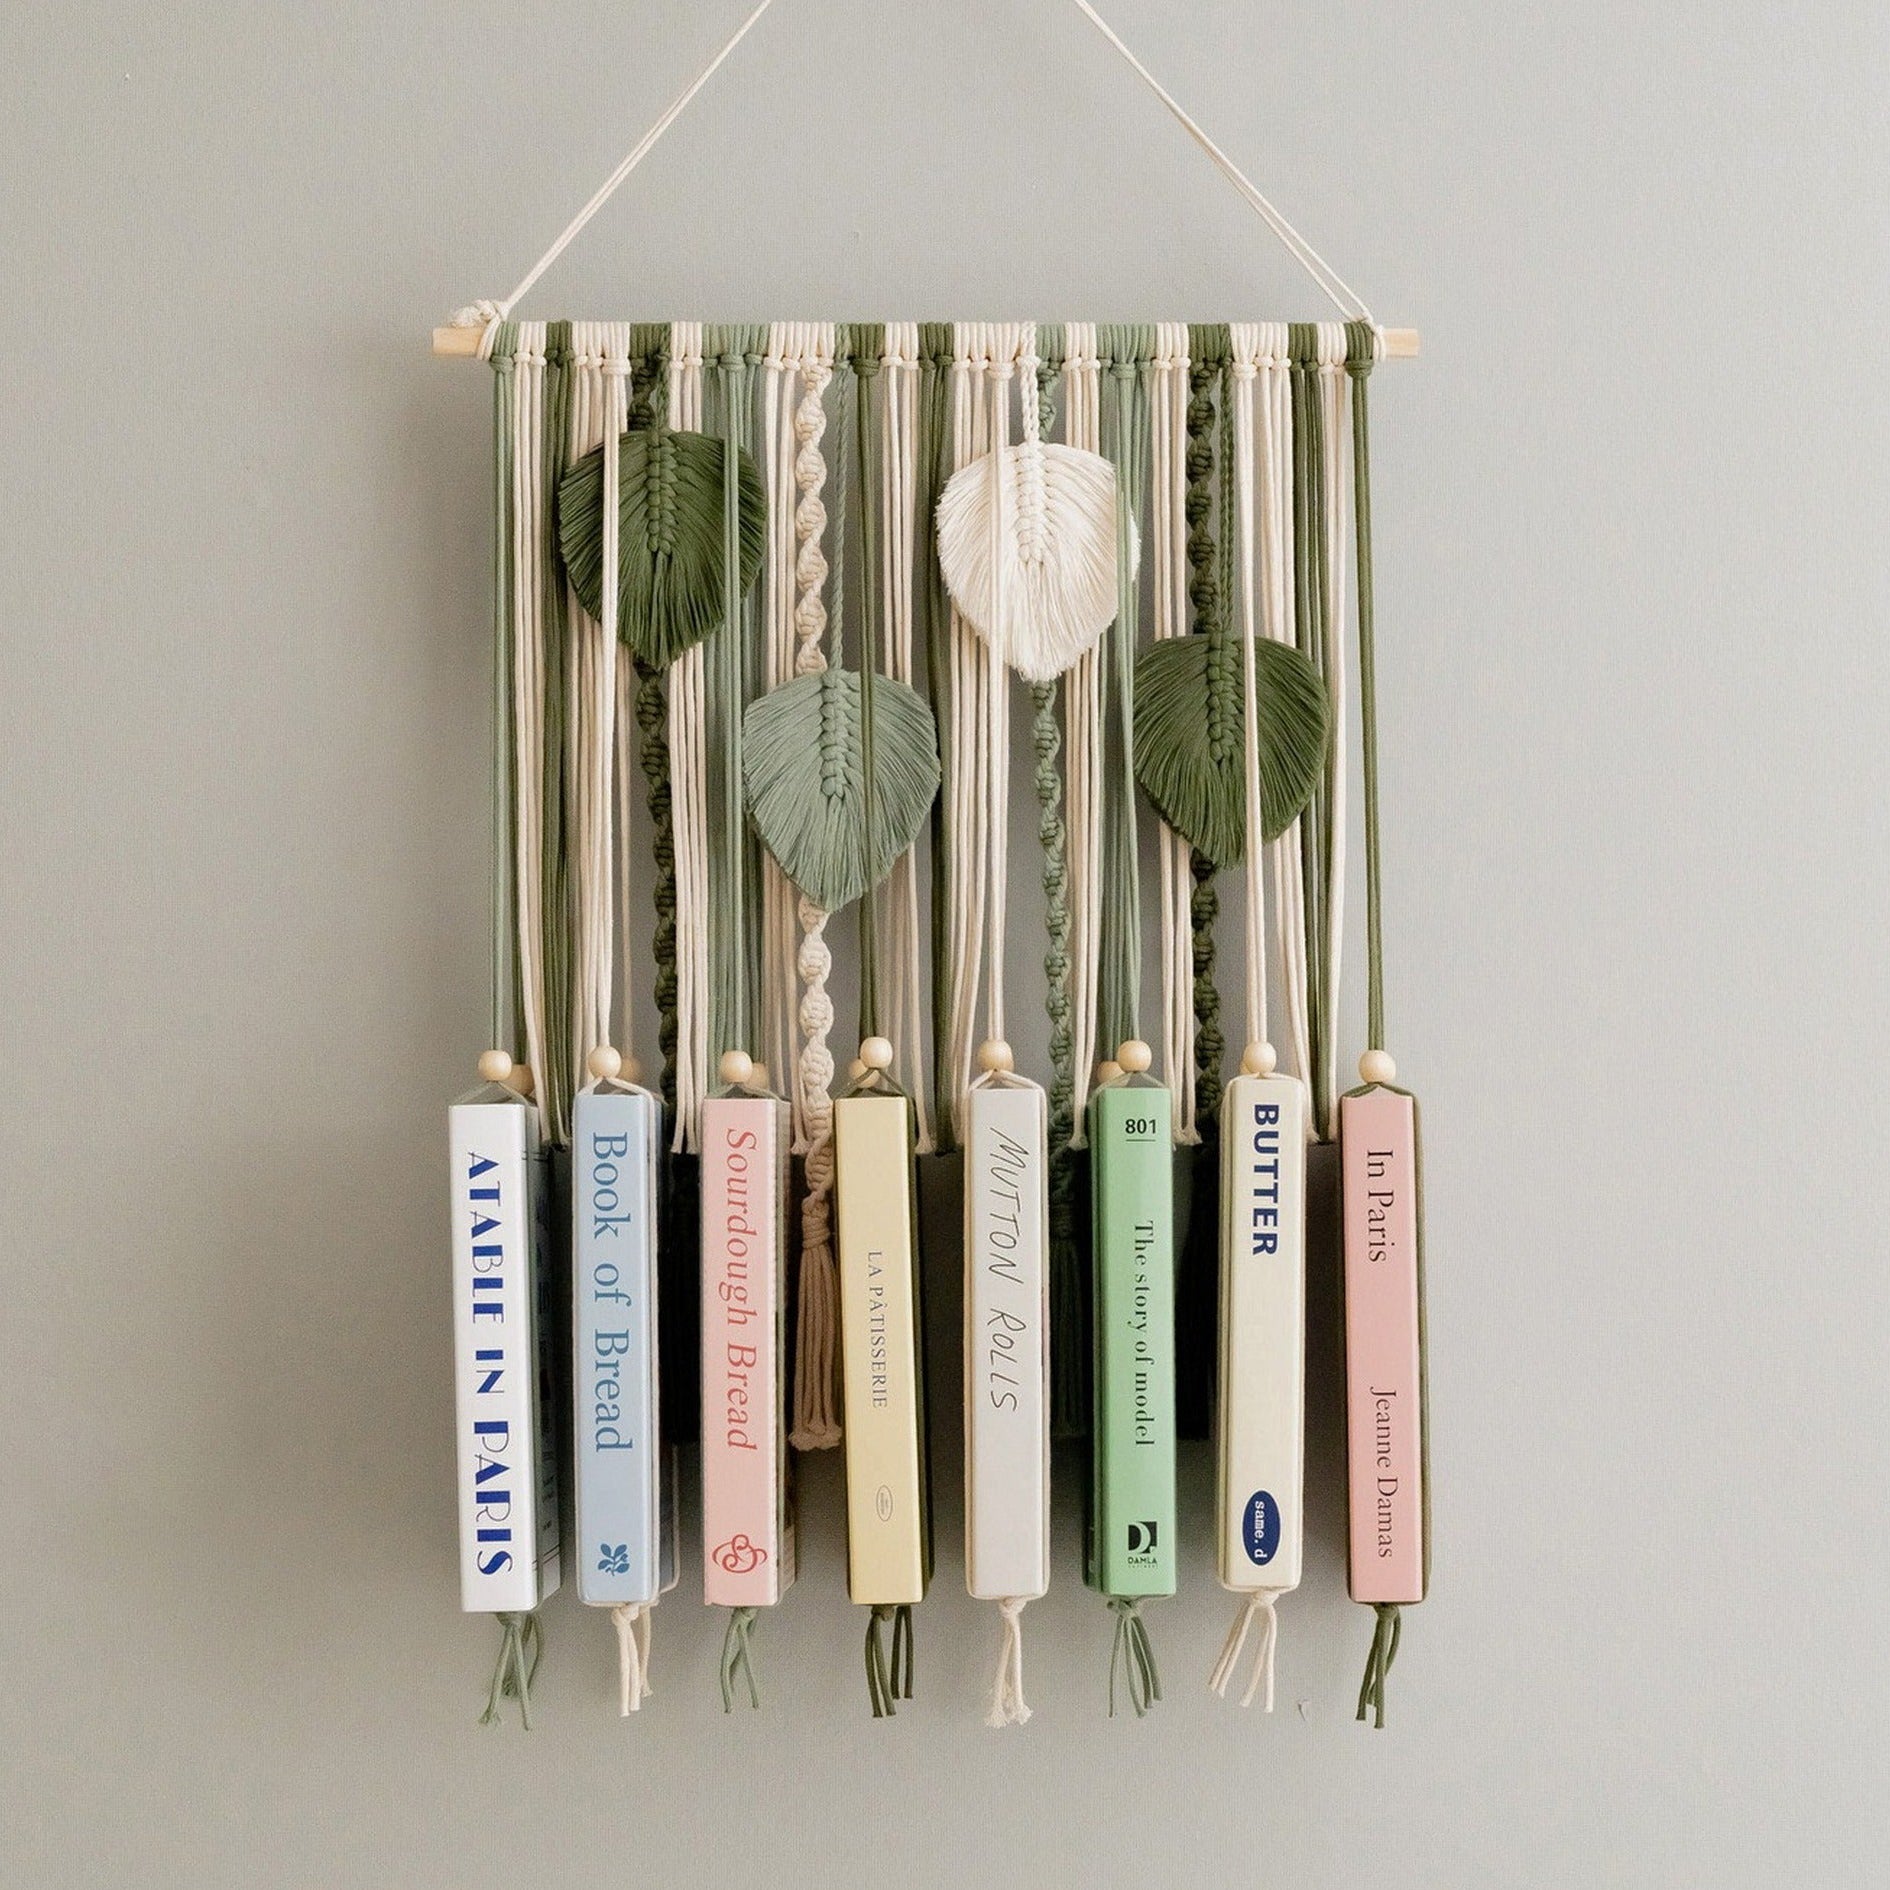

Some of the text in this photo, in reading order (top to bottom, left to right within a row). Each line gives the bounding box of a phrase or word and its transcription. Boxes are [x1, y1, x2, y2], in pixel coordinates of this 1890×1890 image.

[1126, 1119, 1155, 1134] 801
[1253, 1105, 1279, 1255] BUTTER
[987, 1128, 1029, 1411] MUTTON ROLLS
[1368, 1151, 1395, 1262] In Paris
[593, 1132, 632, 1452] Book of Bread
[719, 1128, 757, 1450] Sourdough Bread
[867, 1251, 888, 1408] LA PÂTISSERIE
[1126, 1220, 1154, 1444] The story of model
[476, 1350, 504, 1393] IN
[474, 1421, 512, 1575] PARIS
[1370, 1386, 1399, 1558] Jeanne Damas
